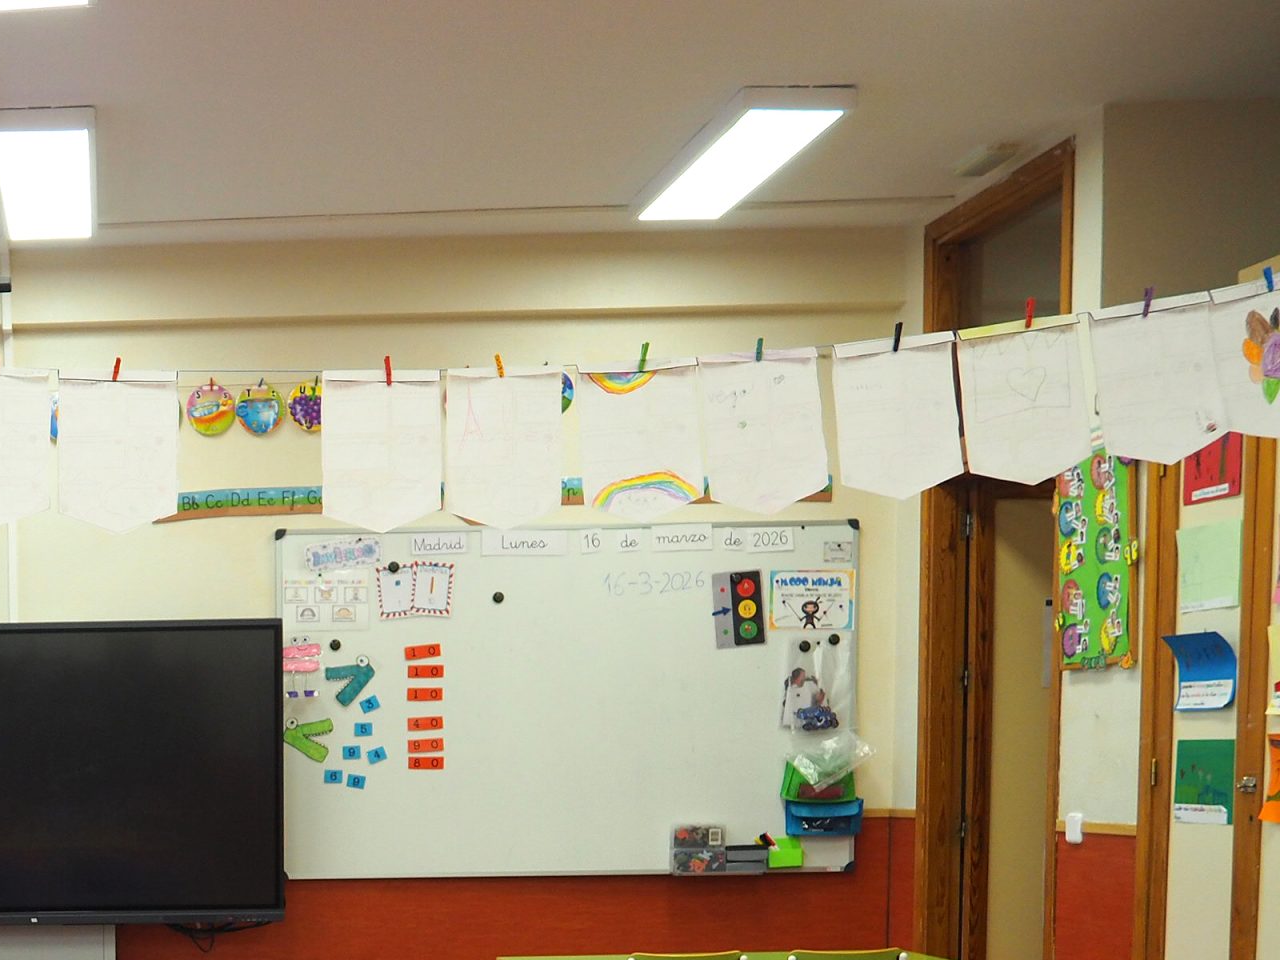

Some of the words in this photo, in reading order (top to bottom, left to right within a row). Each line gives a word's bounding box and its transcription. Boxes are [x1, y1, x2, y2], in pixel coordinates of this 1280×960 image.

[300, 386, 306, 394] U
[182, 496, 200, 511] Bb
[205, 494, 224, 509] Cc
[231, 492, 250, 507] Dd
[258, 491, 276, 506] Ee
[282, 490, 296, 512] Ff
[414, 538, 464, 552] Madrid
[501, 534, 548, 550] Lunes
[584, 532, 601, 549] 16
[620, 534, 640, 549] de
[656, 534, 708, 545] marzo
[724, 532, 744, 547] de
[752, 530, 789, 548] 2026
[604, 571, 705, 596] 16-3-2026
[366, 700, 374, 709] 3
[360, 724, 367, 734] 5
[348, 748, 355, 757] 9
[374, 750, 380, 759] 4
[330, 772, 337, 781] 6
[353, 777, 360, 786] 9
